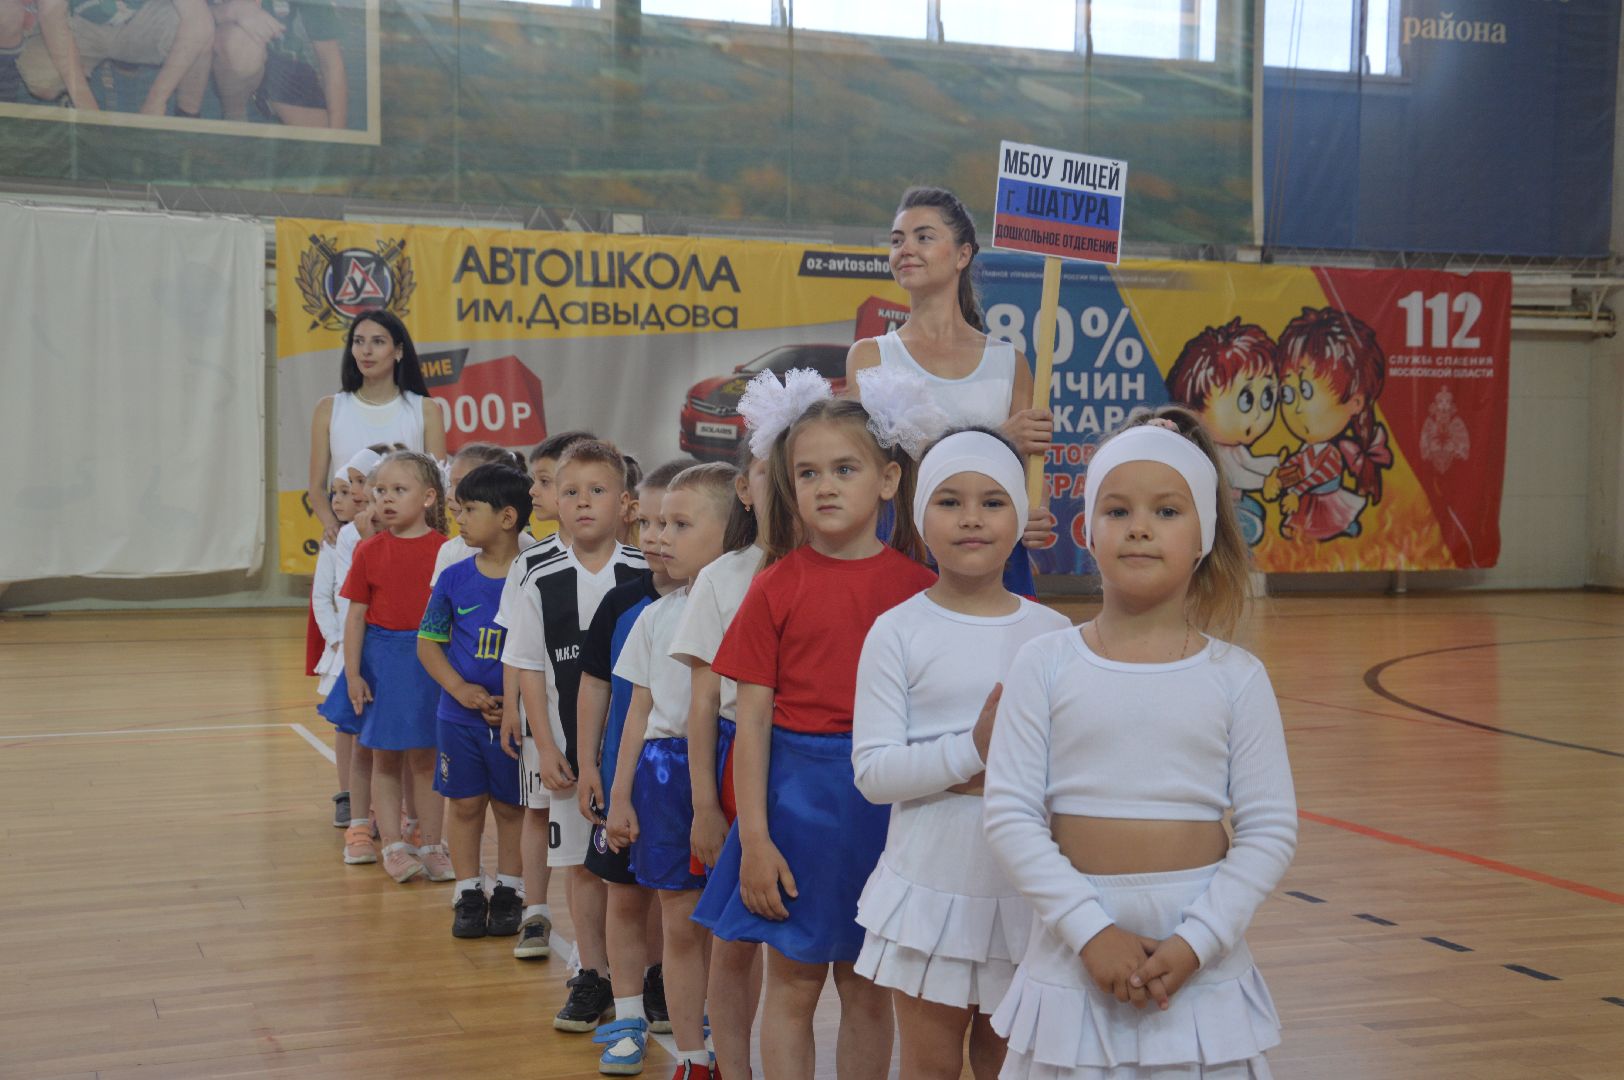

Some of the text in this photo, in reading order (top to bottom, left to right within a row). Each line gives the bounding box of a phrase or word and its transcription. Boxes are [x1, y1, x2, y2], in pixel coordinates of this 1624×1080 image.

[1402, 12, 1507, 45] района
[1004, 148, 1121, 191] МБОУ ЛИЦЕЙ
[1026, 186, 1110, 226] ШАТУРА
[995, 223, 1118, 255] ДОШКОЛЬНОЕ ОТДЕЛЕНИЕ
[452, 244, 741, 293] АВТОШКОЛА
[1397, 291, 1482, 348] 112
[701, 426, 733, 434] SOLARIS
[475, 626, 502, 660] 10
